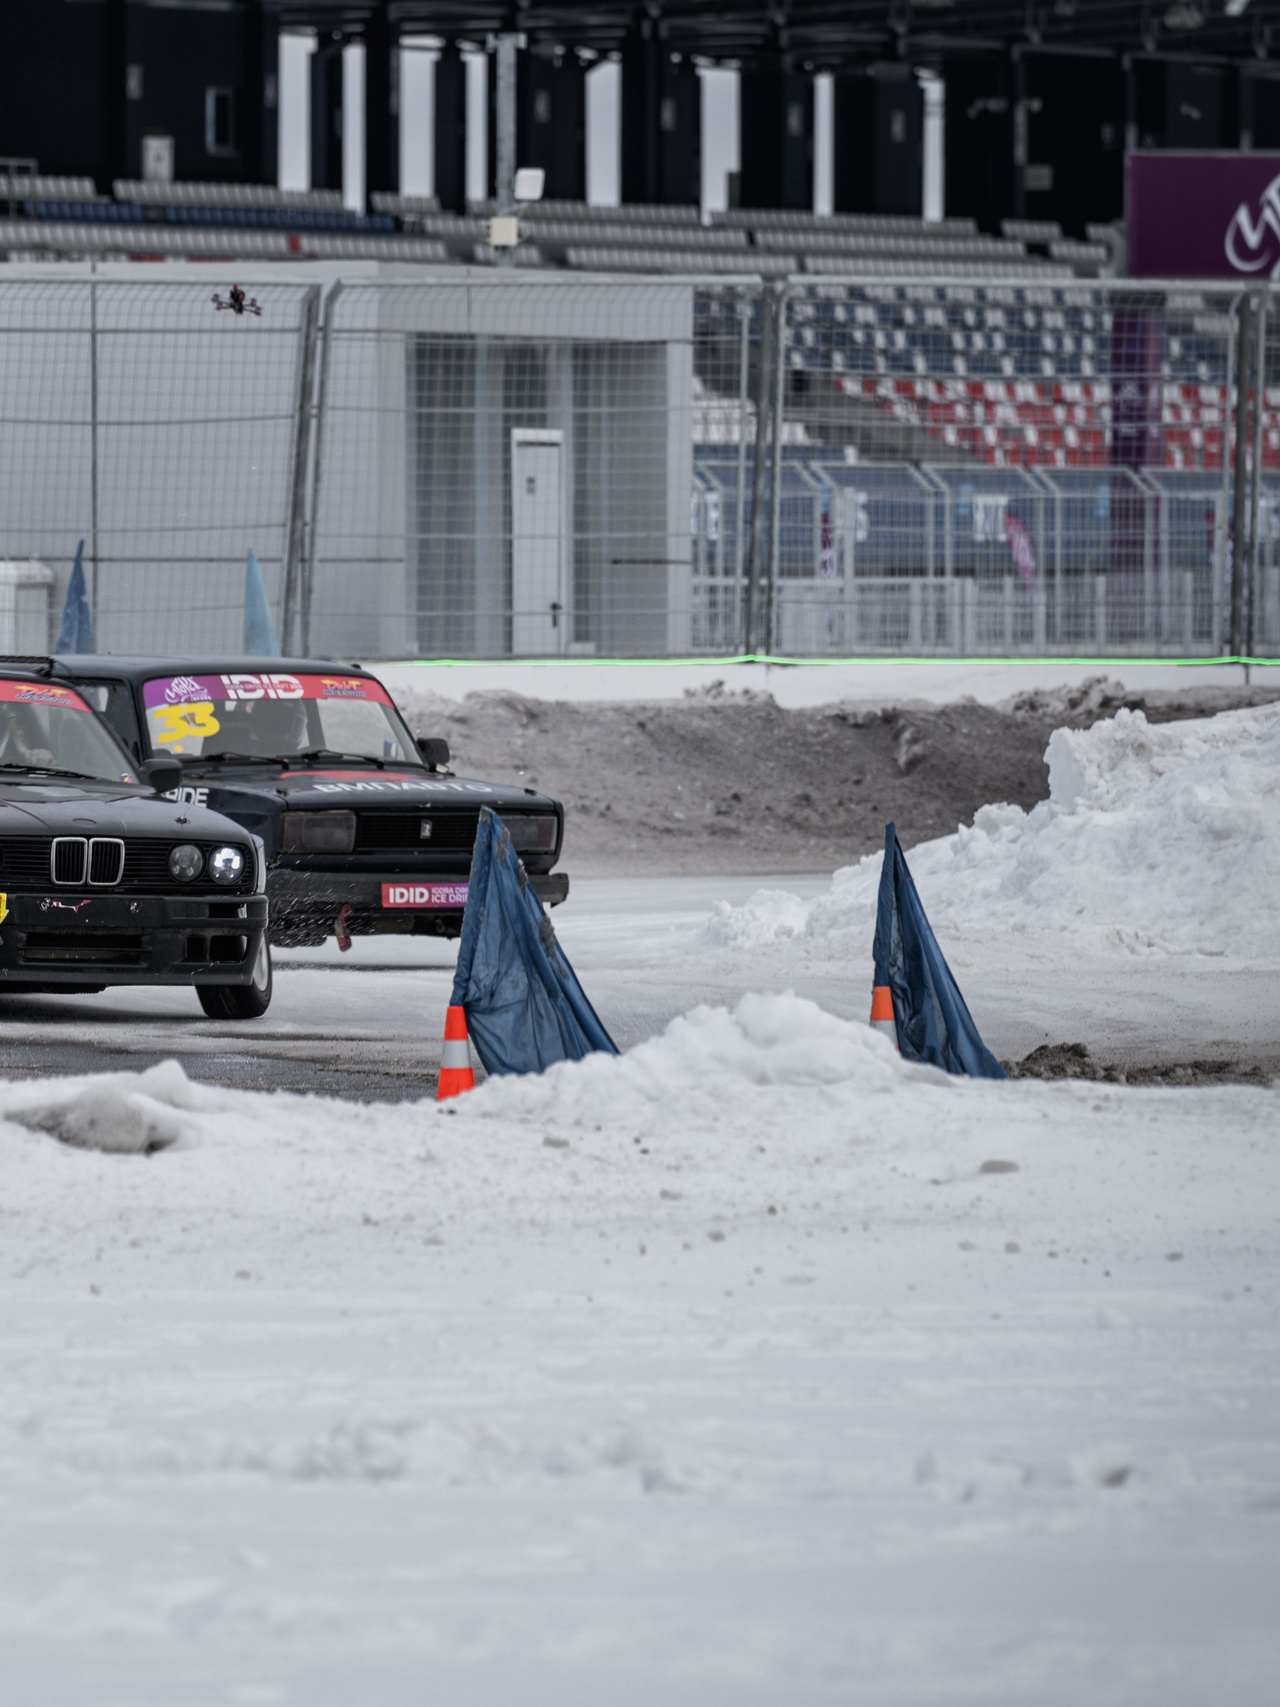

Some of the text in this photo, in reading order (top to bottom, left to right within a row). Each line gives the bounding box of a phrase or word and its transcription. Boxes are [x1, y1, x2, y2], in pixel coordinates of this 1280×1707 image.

[154, 702, 219, 743] 33
[388, 886, 430, 904] IDID
[431, 886, 454, 894] IGORA
[431, 894, 447, 903] ICE
